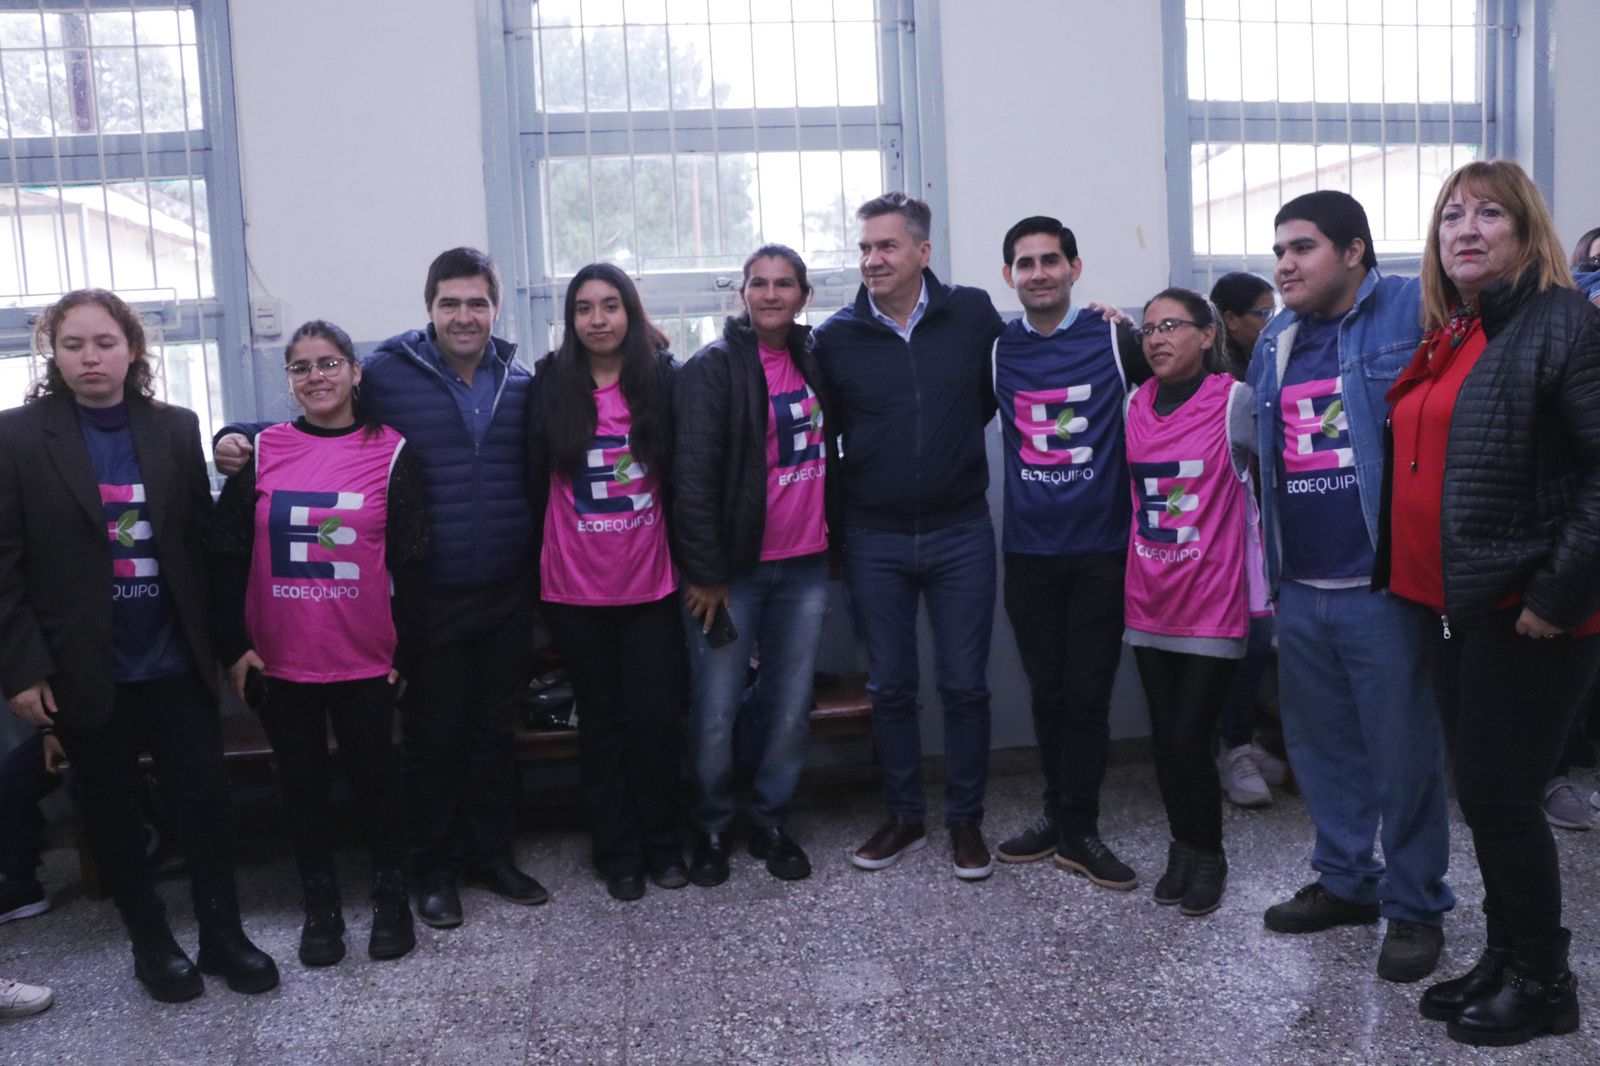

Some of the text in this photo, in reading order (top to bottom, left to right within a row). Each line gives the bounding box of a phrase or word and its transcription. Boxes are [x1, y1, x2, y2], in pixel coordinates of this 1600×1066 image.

[1286, 474, 1359, 494] ECOEQUIP
[577, 513, 655, 533] ECOEQUIPO
[272, 584, 360, 602] ECOEQUIPO
